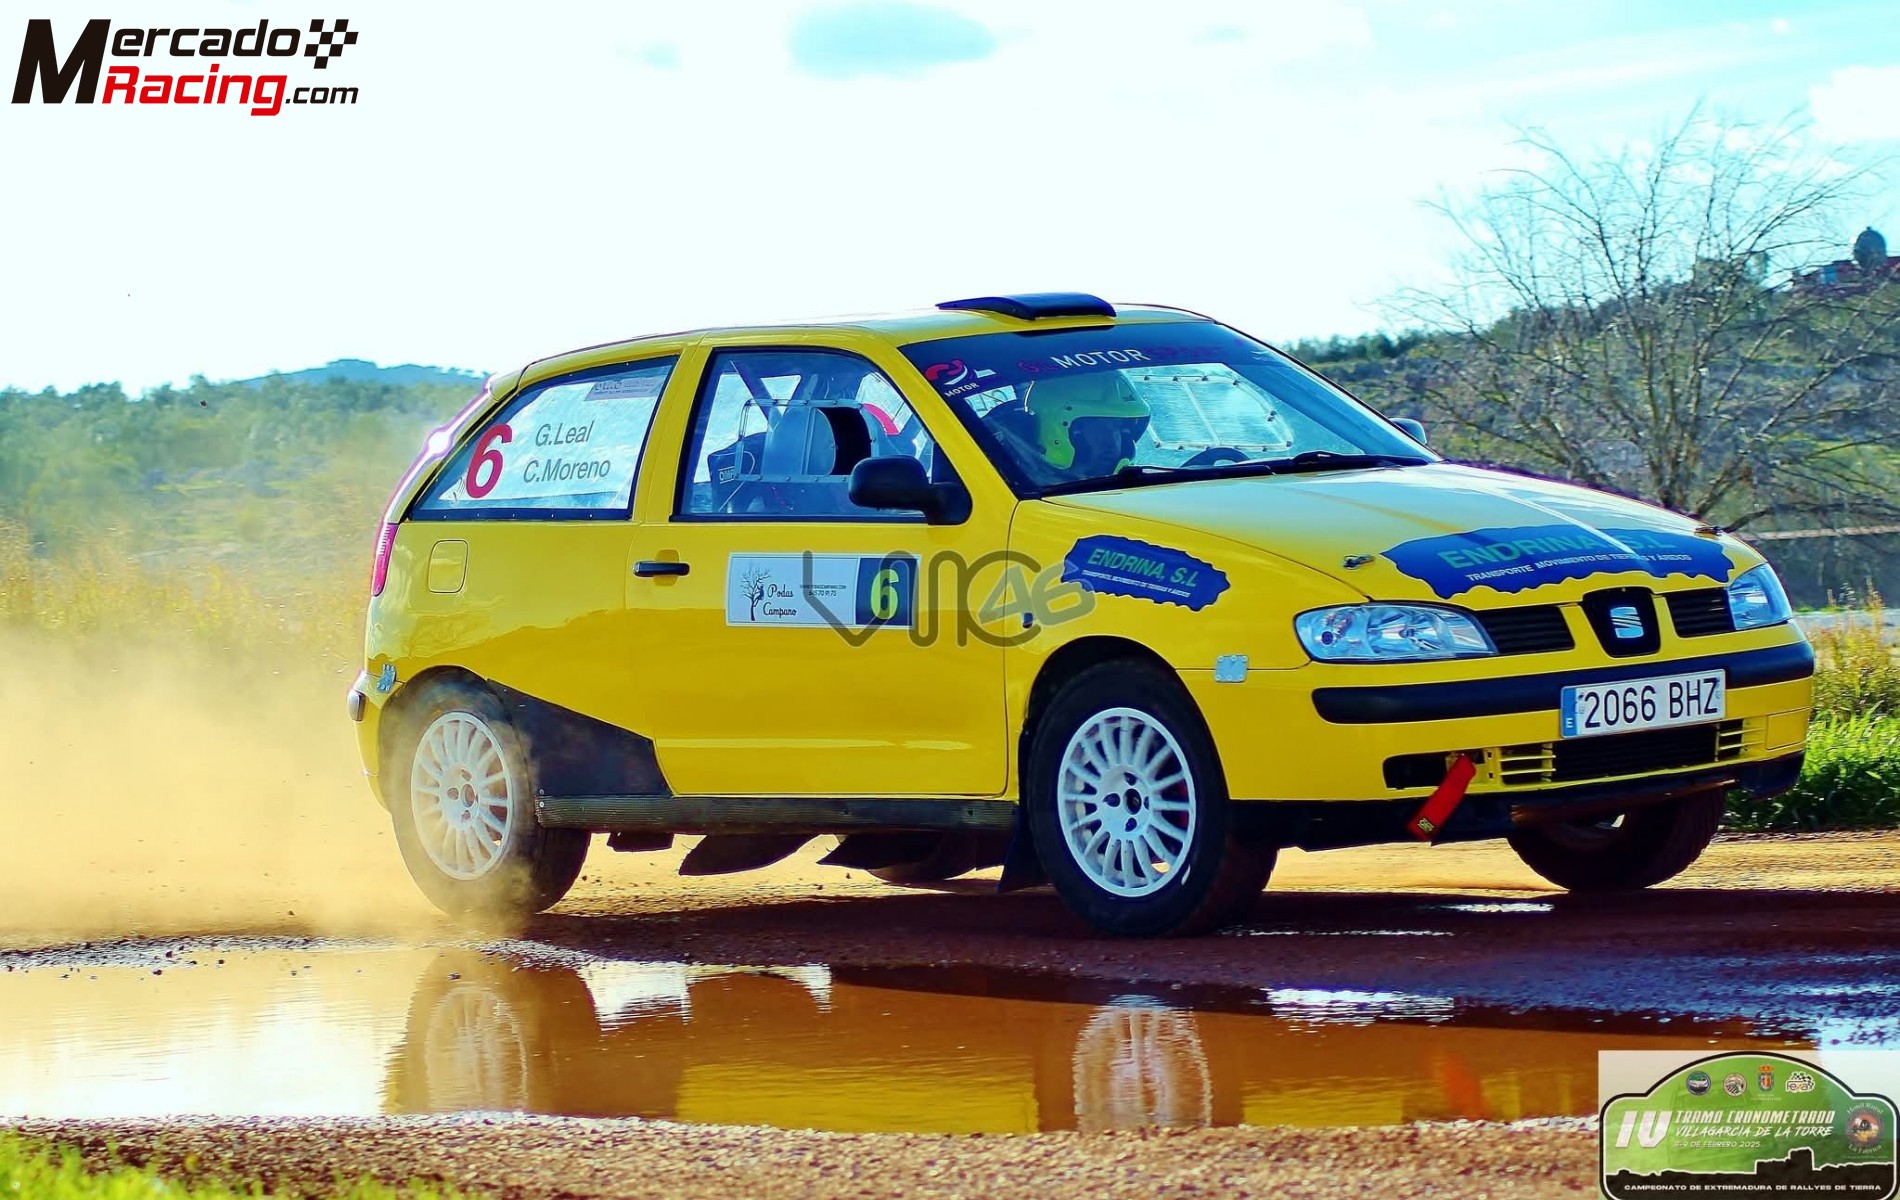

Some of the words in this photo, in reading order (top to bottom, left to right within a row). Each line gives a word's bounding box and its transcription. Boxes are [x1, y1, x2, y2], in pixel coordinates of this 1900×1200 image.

[944, 382, 980, 398] MOTOR
[535, 420, 595, 447] G.Leal
[466, 423, 513, 499] 6
[523, 459, 611, 483] C.Moreno
[1465, 564, 1534, 581] TRANSPORTE
[767, 583, 794, 598] Podas
[870, 569, 899, 620] 6
[763, 601, 797, 619] Campano
[1584, 684, 1657, 729] 2066
[1668, 677, 1720, 719] BHZ
[1565, 717, 1574, 729] E
